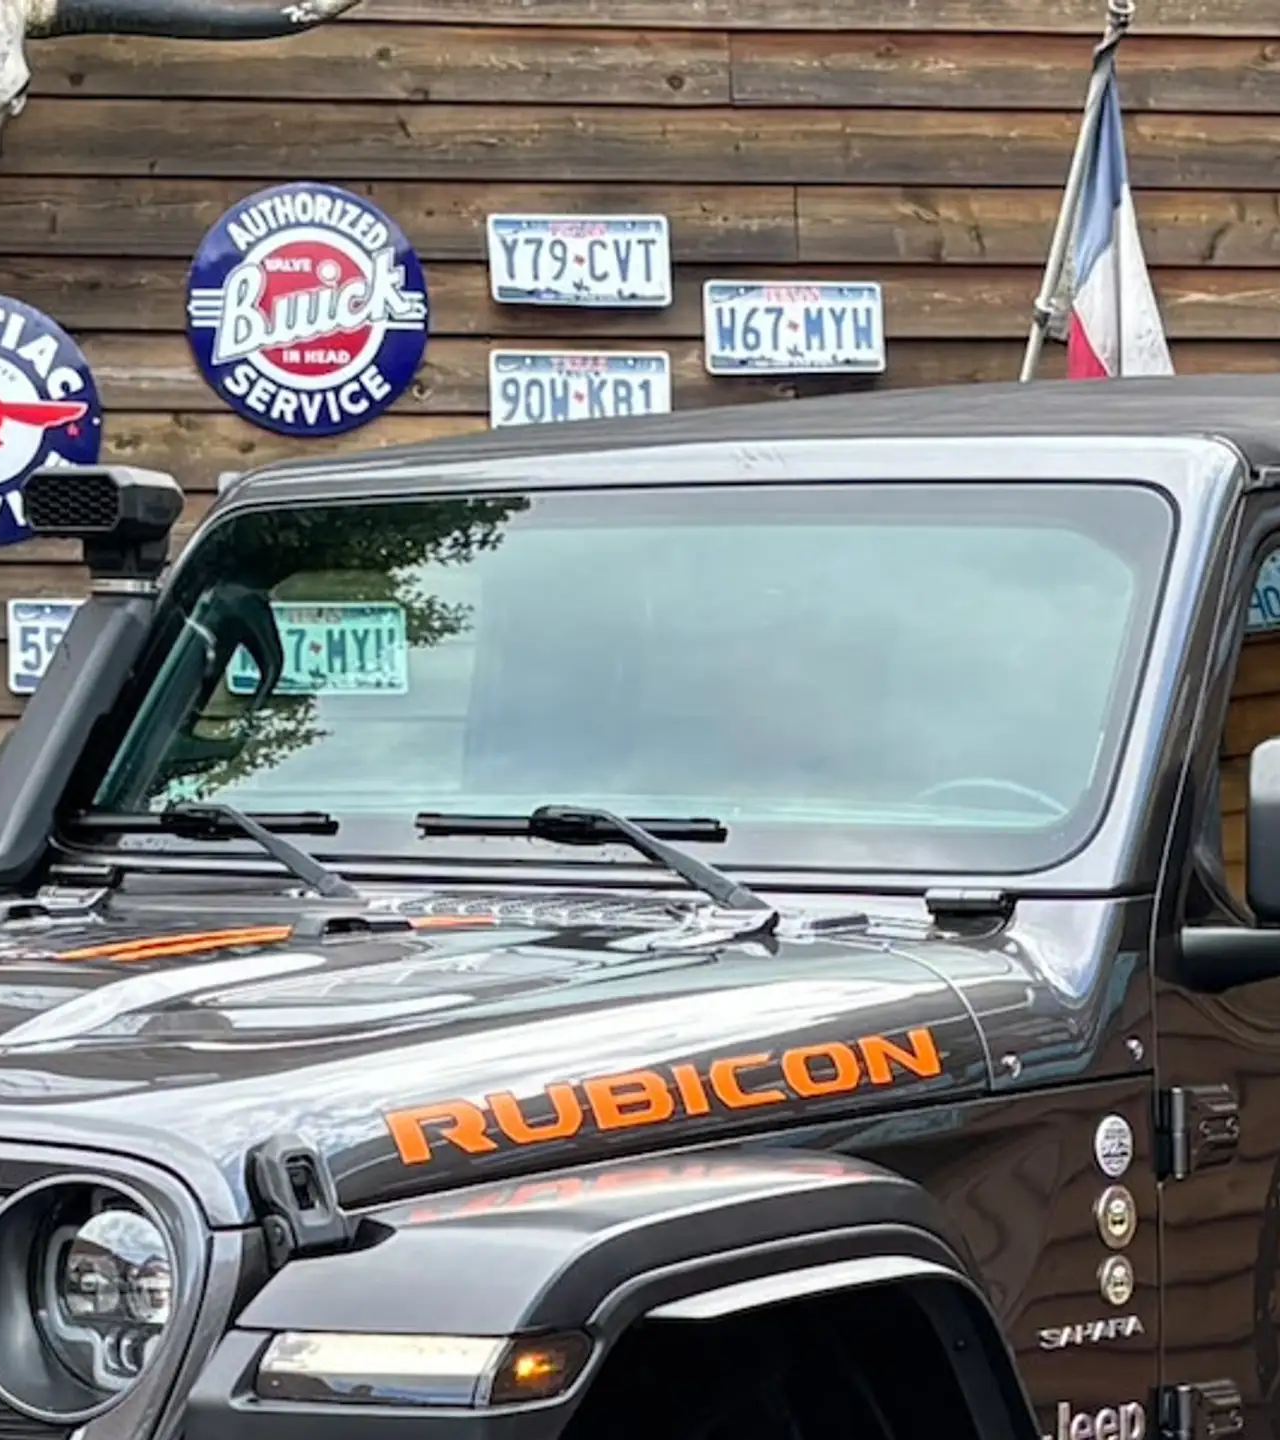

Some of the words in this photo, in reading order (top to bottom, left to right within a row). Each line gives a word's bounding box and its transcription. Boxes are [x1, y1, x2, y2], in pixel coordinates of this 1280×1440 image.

[227, 191, 390, 251] AUTHORIZED
[499, 237, 567, 281] Y79
[588, 239, 658, 283] CVT
[211, 246, 412, 366] Buick
[282, 350, 301, 364] IN
[303, 350, 352, 365] HEAD
[223, 364, 392, 426] SERVICE
[384, 1026, 942, 1166] RUBICON
[1037, 1315, 1146, 1350] SAHARA
